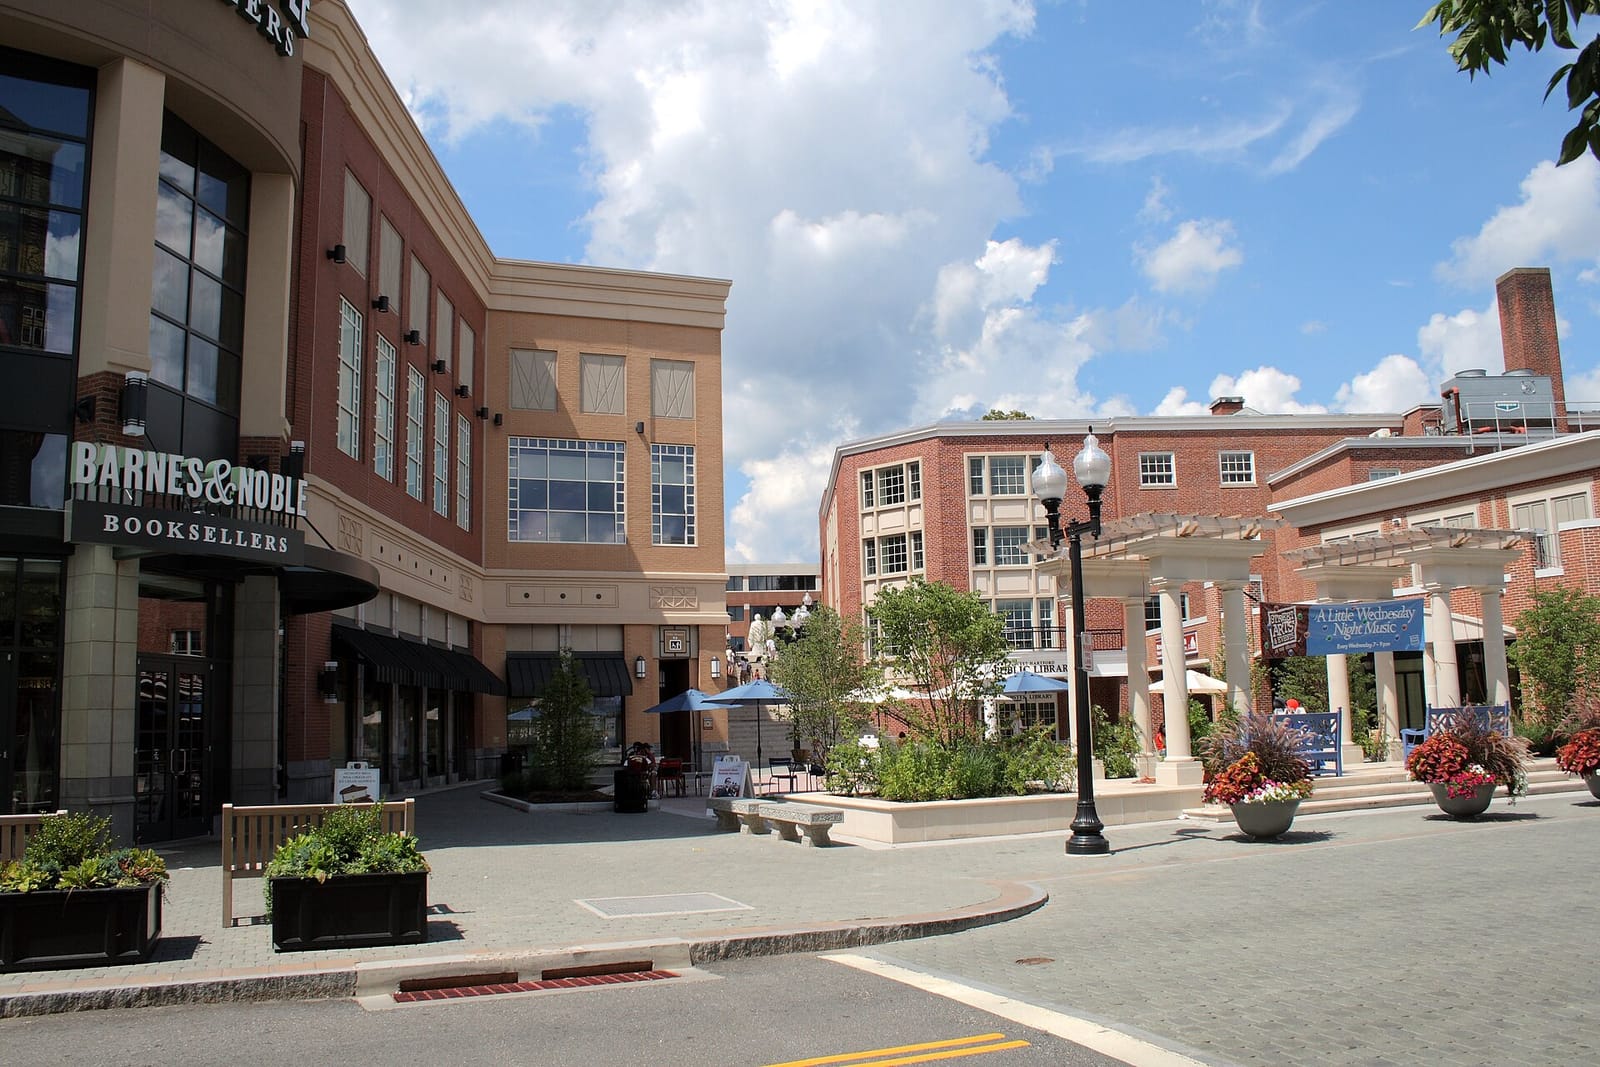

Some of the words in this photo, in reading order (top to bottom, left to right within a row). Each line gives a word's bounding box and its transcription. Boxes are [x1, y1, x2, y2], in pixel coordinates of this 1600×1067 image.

[72, 442, 204, 498] BARNES
[203, 458, 237, 506] &
[237, 467, 308, 517] NOBLE
[103, 514, 289, 554] BOOKSELLERS
[1317, 608, 1326, 622] A
[1327, 607, 1354, 622] Little
[1355, 605, 1416, 623] Wednesday
[1273, 620, 1295, 637] ARTS
[1333, 622, 1362, 640] Night
[1364, 620, 1397, 635] Music
[1033, 664, 1068, 673] LIBRAR
